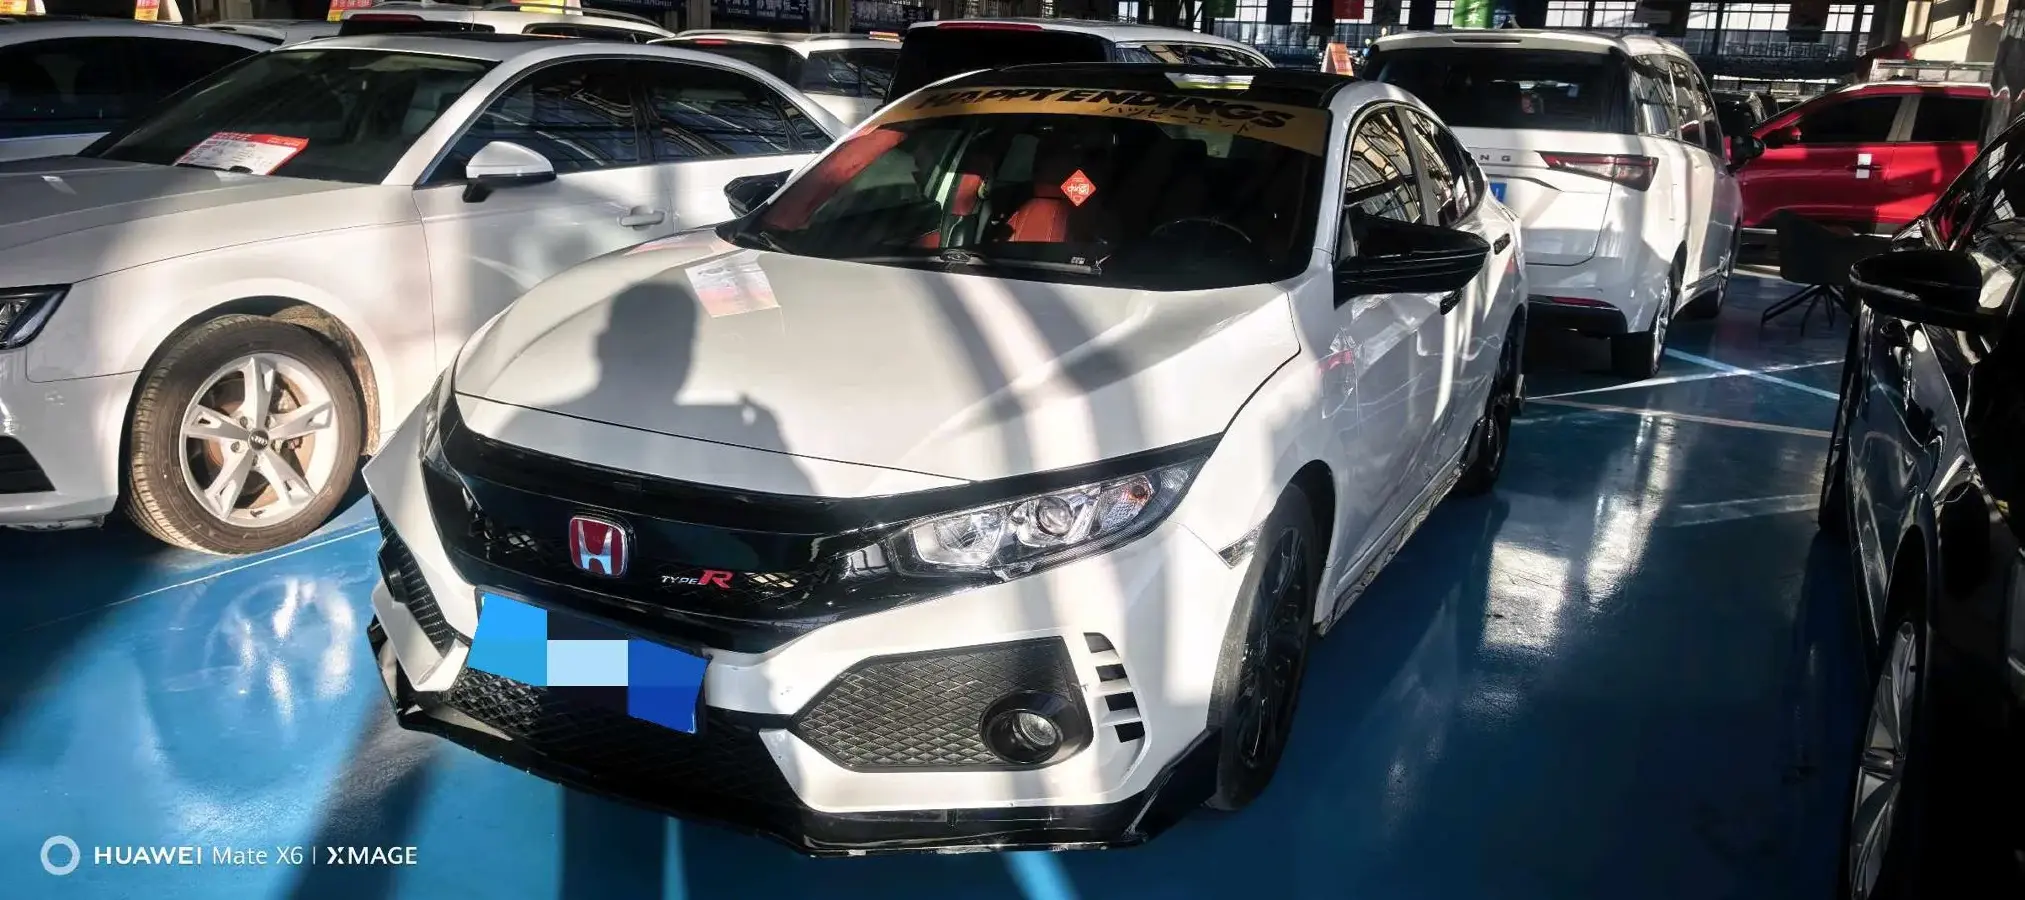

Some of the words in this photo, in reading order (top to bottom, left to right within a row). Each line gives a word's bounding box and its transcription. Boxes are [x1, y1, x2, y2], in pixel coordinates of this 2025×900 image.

[914, 89, 1068, 110] HAPPY
[1056, 90, 1296, 129] ENDINGS
[660, 575, 700, 586] TYPE
